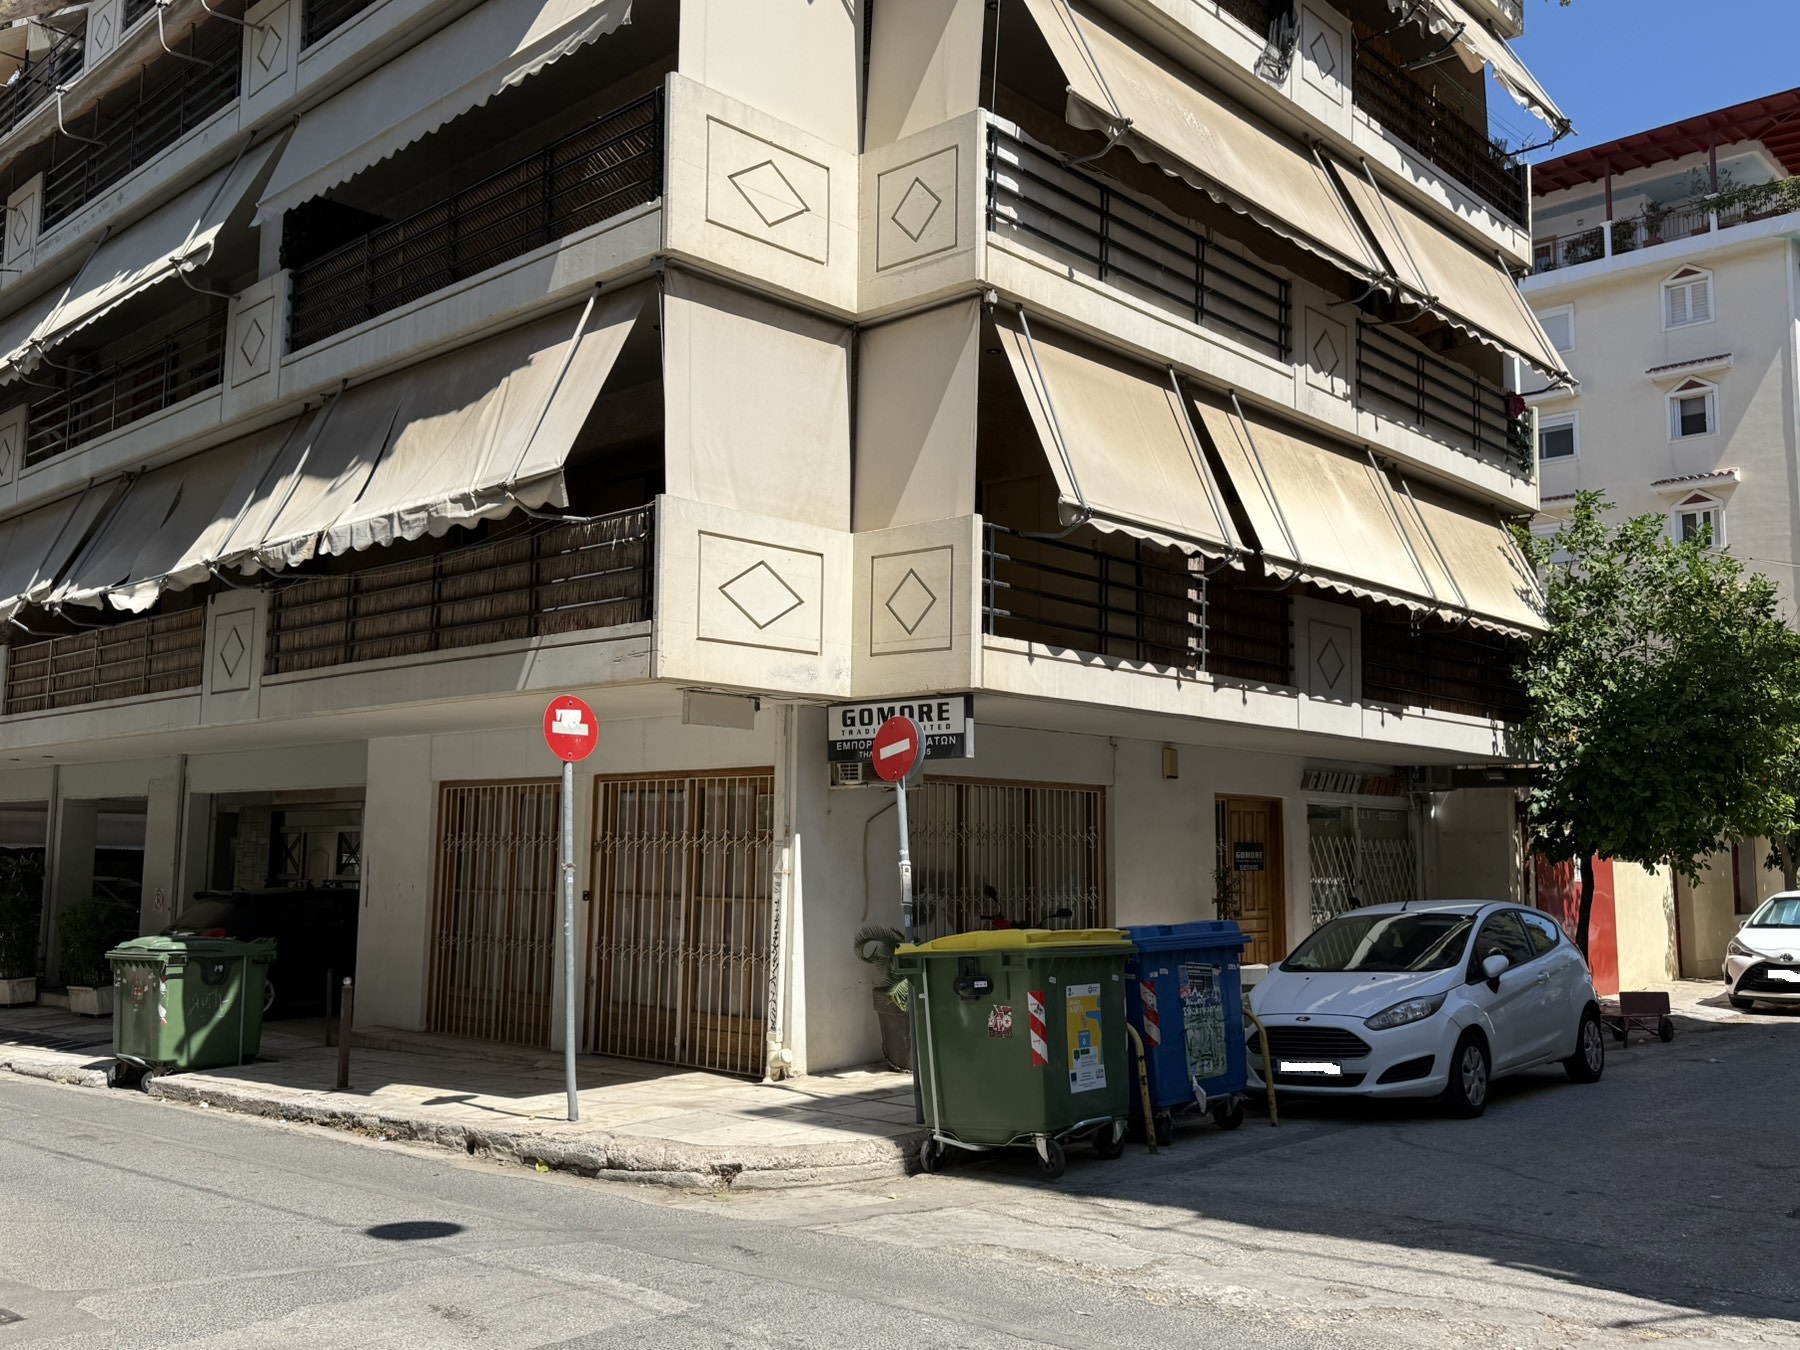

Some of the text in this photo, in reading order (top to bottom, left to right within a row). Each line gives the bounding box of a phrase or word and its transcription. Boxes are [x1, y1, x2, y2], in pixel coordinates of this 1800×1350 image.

[841, 703, 950, 728] GOMORE
[841, 728, 876, 736] TRADI
[1307, 770, 1362, 795] GOMORE
[1235, 851, 1263, 859] GOMORE
